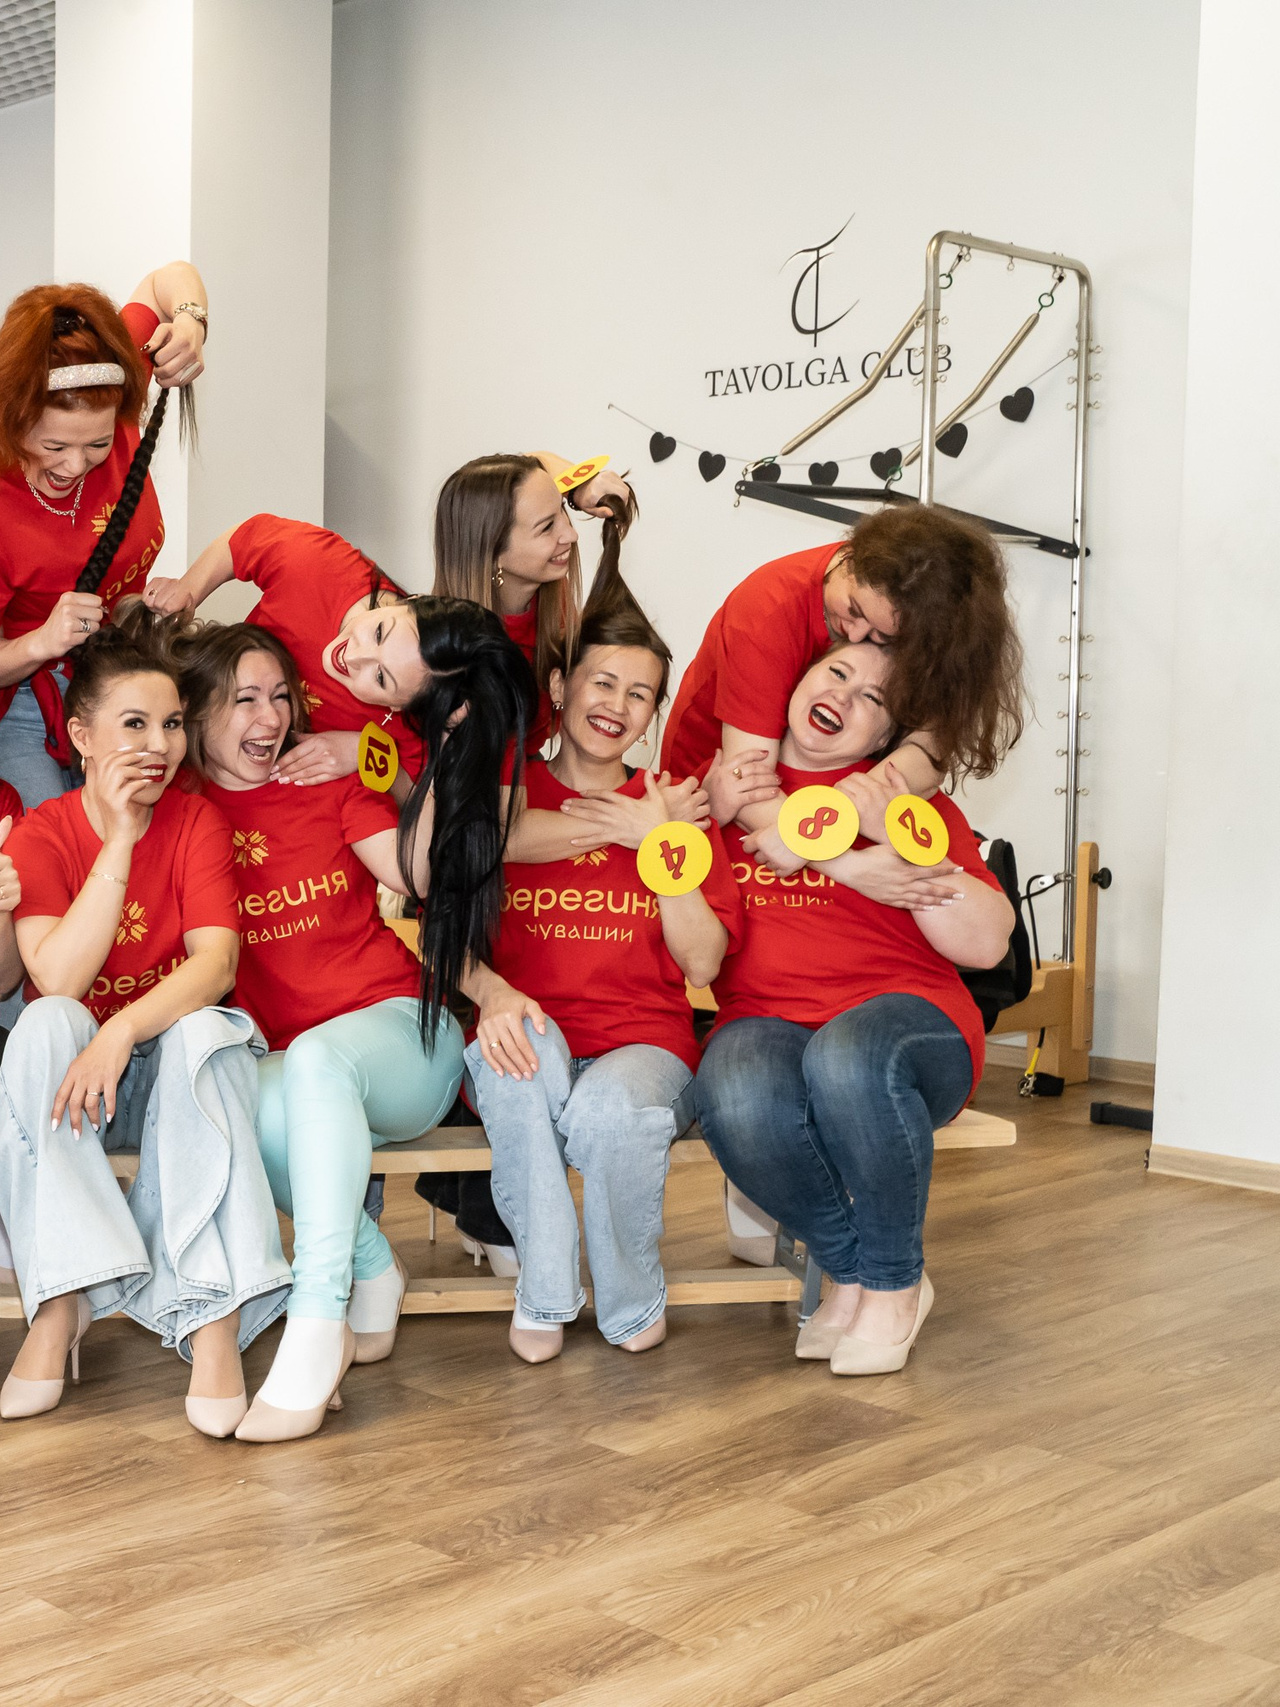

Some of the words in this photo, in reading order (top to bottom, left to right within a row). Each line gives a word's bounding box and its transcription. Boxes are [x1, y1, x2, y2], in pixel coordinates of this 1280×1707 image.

[705, 356, 850, 397] TAVOLGA
[558, 464, 595, 487] 10
[364, 735, 392, 779] 12
[798, 806, 839, 840] 8
[898, 807, 932, 849] 2
[659, 839, 687, 880] 4
[237, 870, 349, 917] егиня
[240, 914, 320, 948] вашии
[525, 923, 633, 943] чувашии
